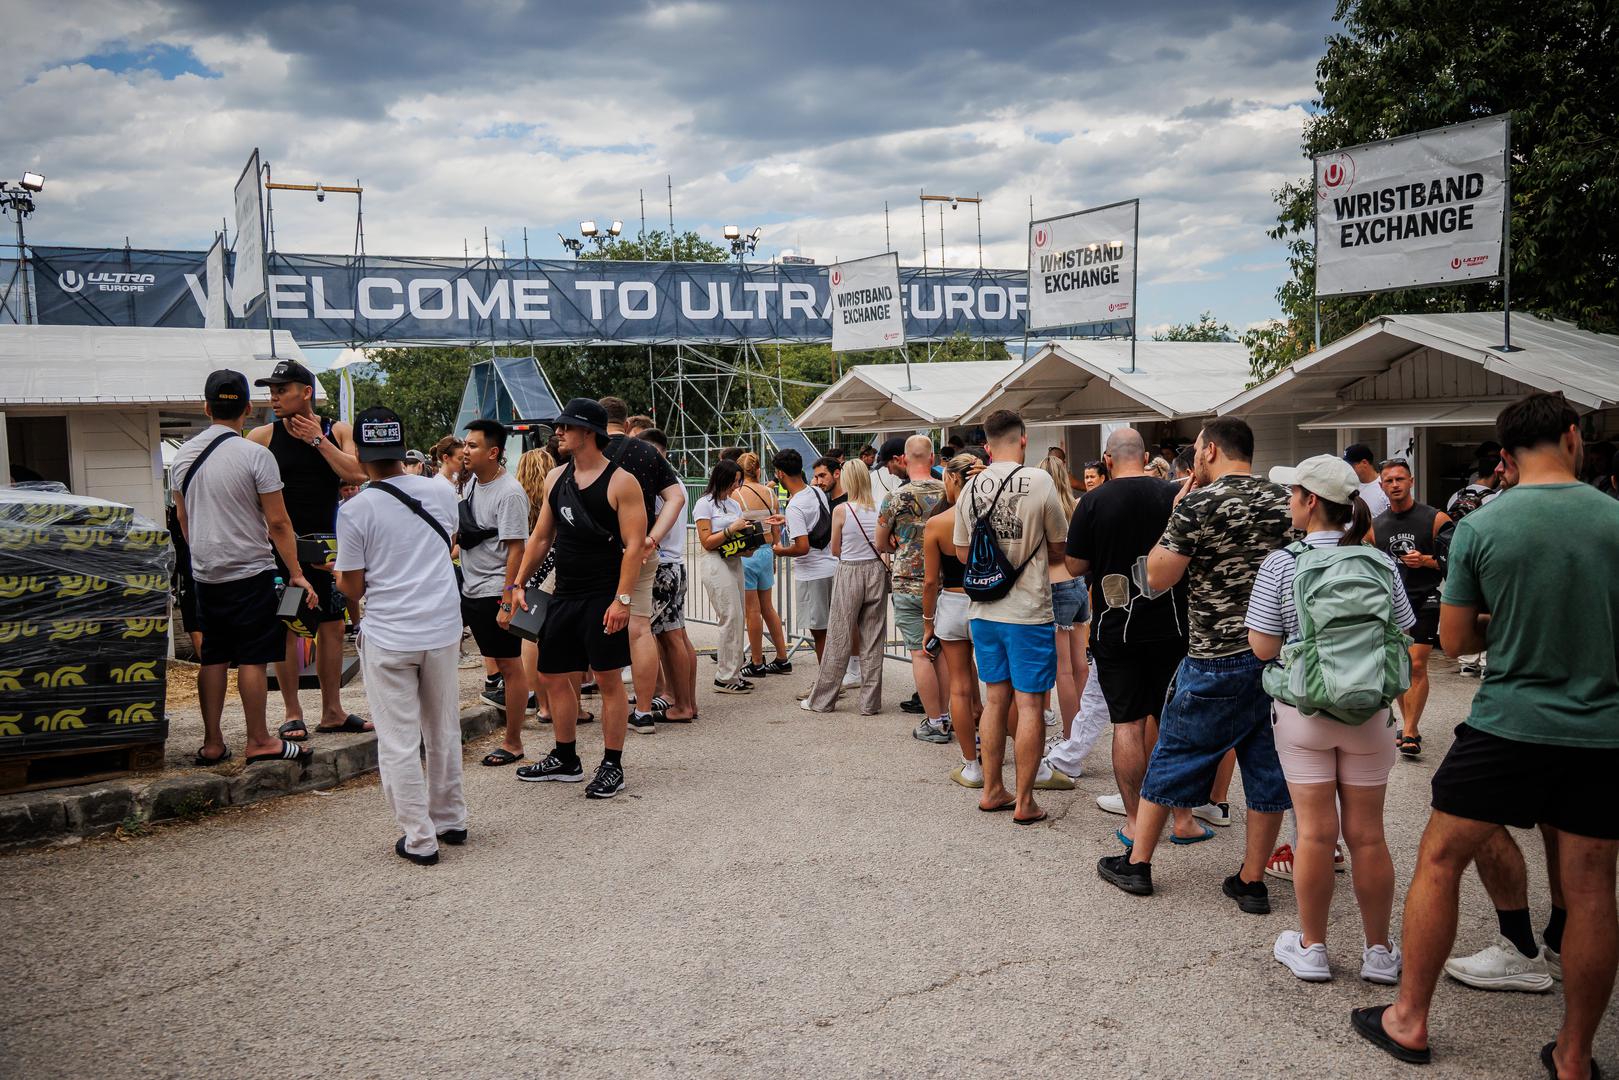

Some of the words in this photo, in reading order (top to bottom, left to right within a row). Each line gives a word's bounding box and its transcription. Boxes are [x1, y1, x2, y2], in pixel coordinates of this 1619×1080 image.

[1333, 172, 1484, 221] WRISTBAND
[1340, 204, 1475, 248] EXCHANGE
[1040, 242, 1124, 273] WRISTBAND
[87, 272, 155, 283] ULTRA
[100, 284, 145, 292] EUROPE
[1045, 264, 1119, 294] EXCHANGE
[575, 281, 656, 320] TO
[680, 281, 833, 320] ULTR
[901, 284, 1027, 320] UROP
[837, 285, 893, 308] WRISTBAND
[843, 304, 891, 325] EXCHANGE
[1397, 533, 1415, 541] GALLO
